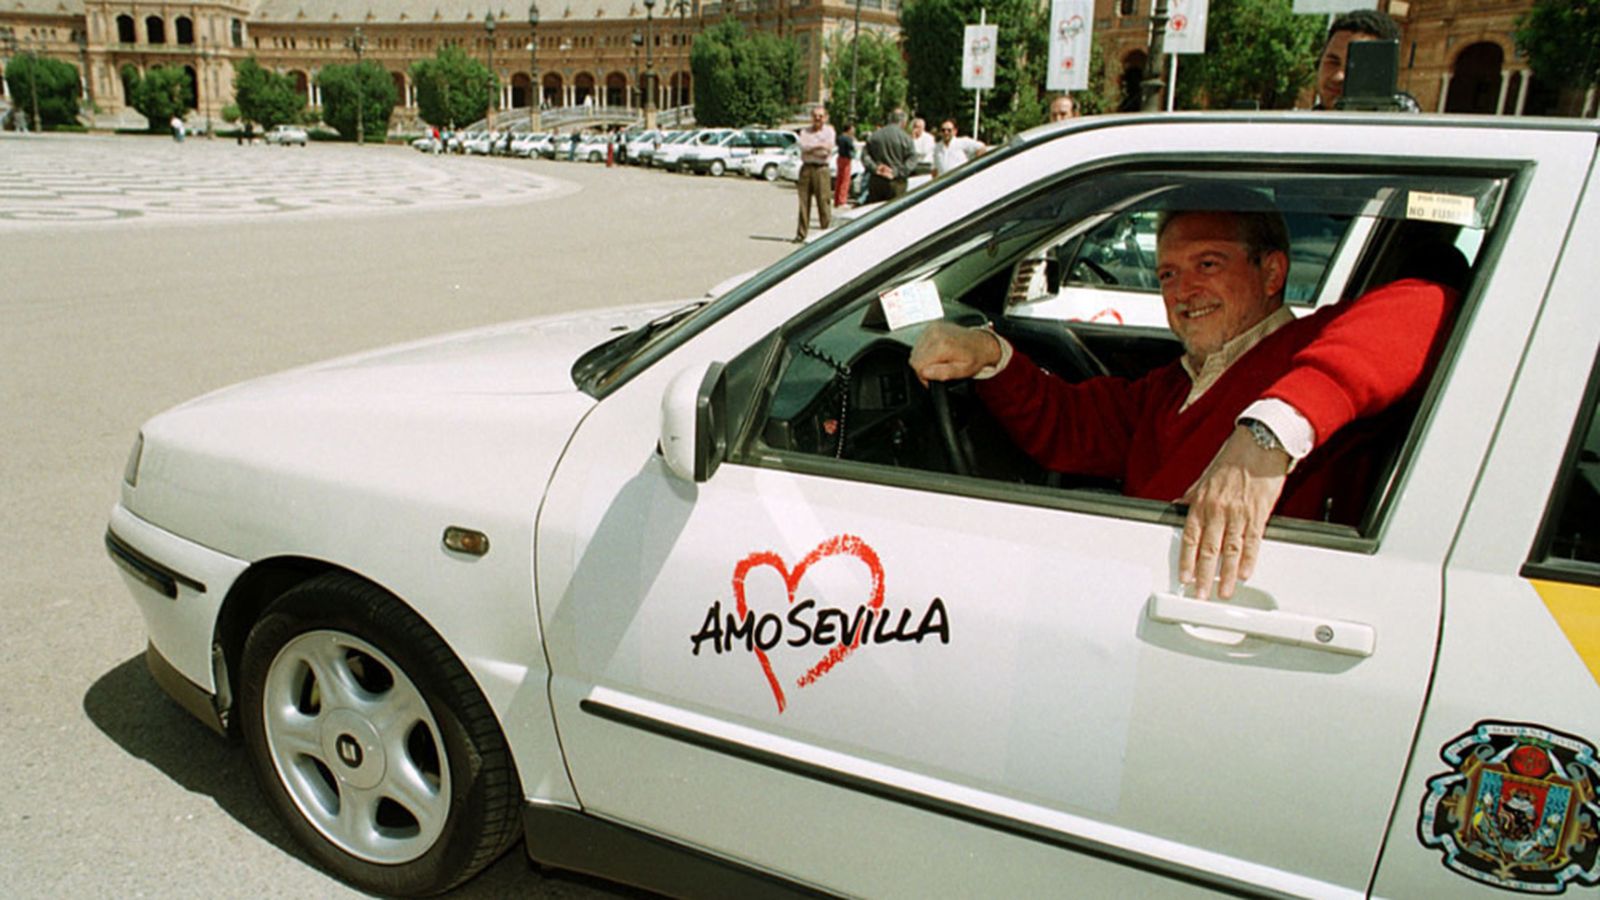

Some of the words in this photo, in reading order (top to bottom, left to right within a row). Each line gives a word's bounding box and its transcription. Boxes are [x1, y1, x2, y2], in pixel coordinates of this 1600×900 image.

[1409, 206, 1425, 217] NO
[691, 600, 783, 656] AMO
[787, 597, 950, 648] SEVILLA
